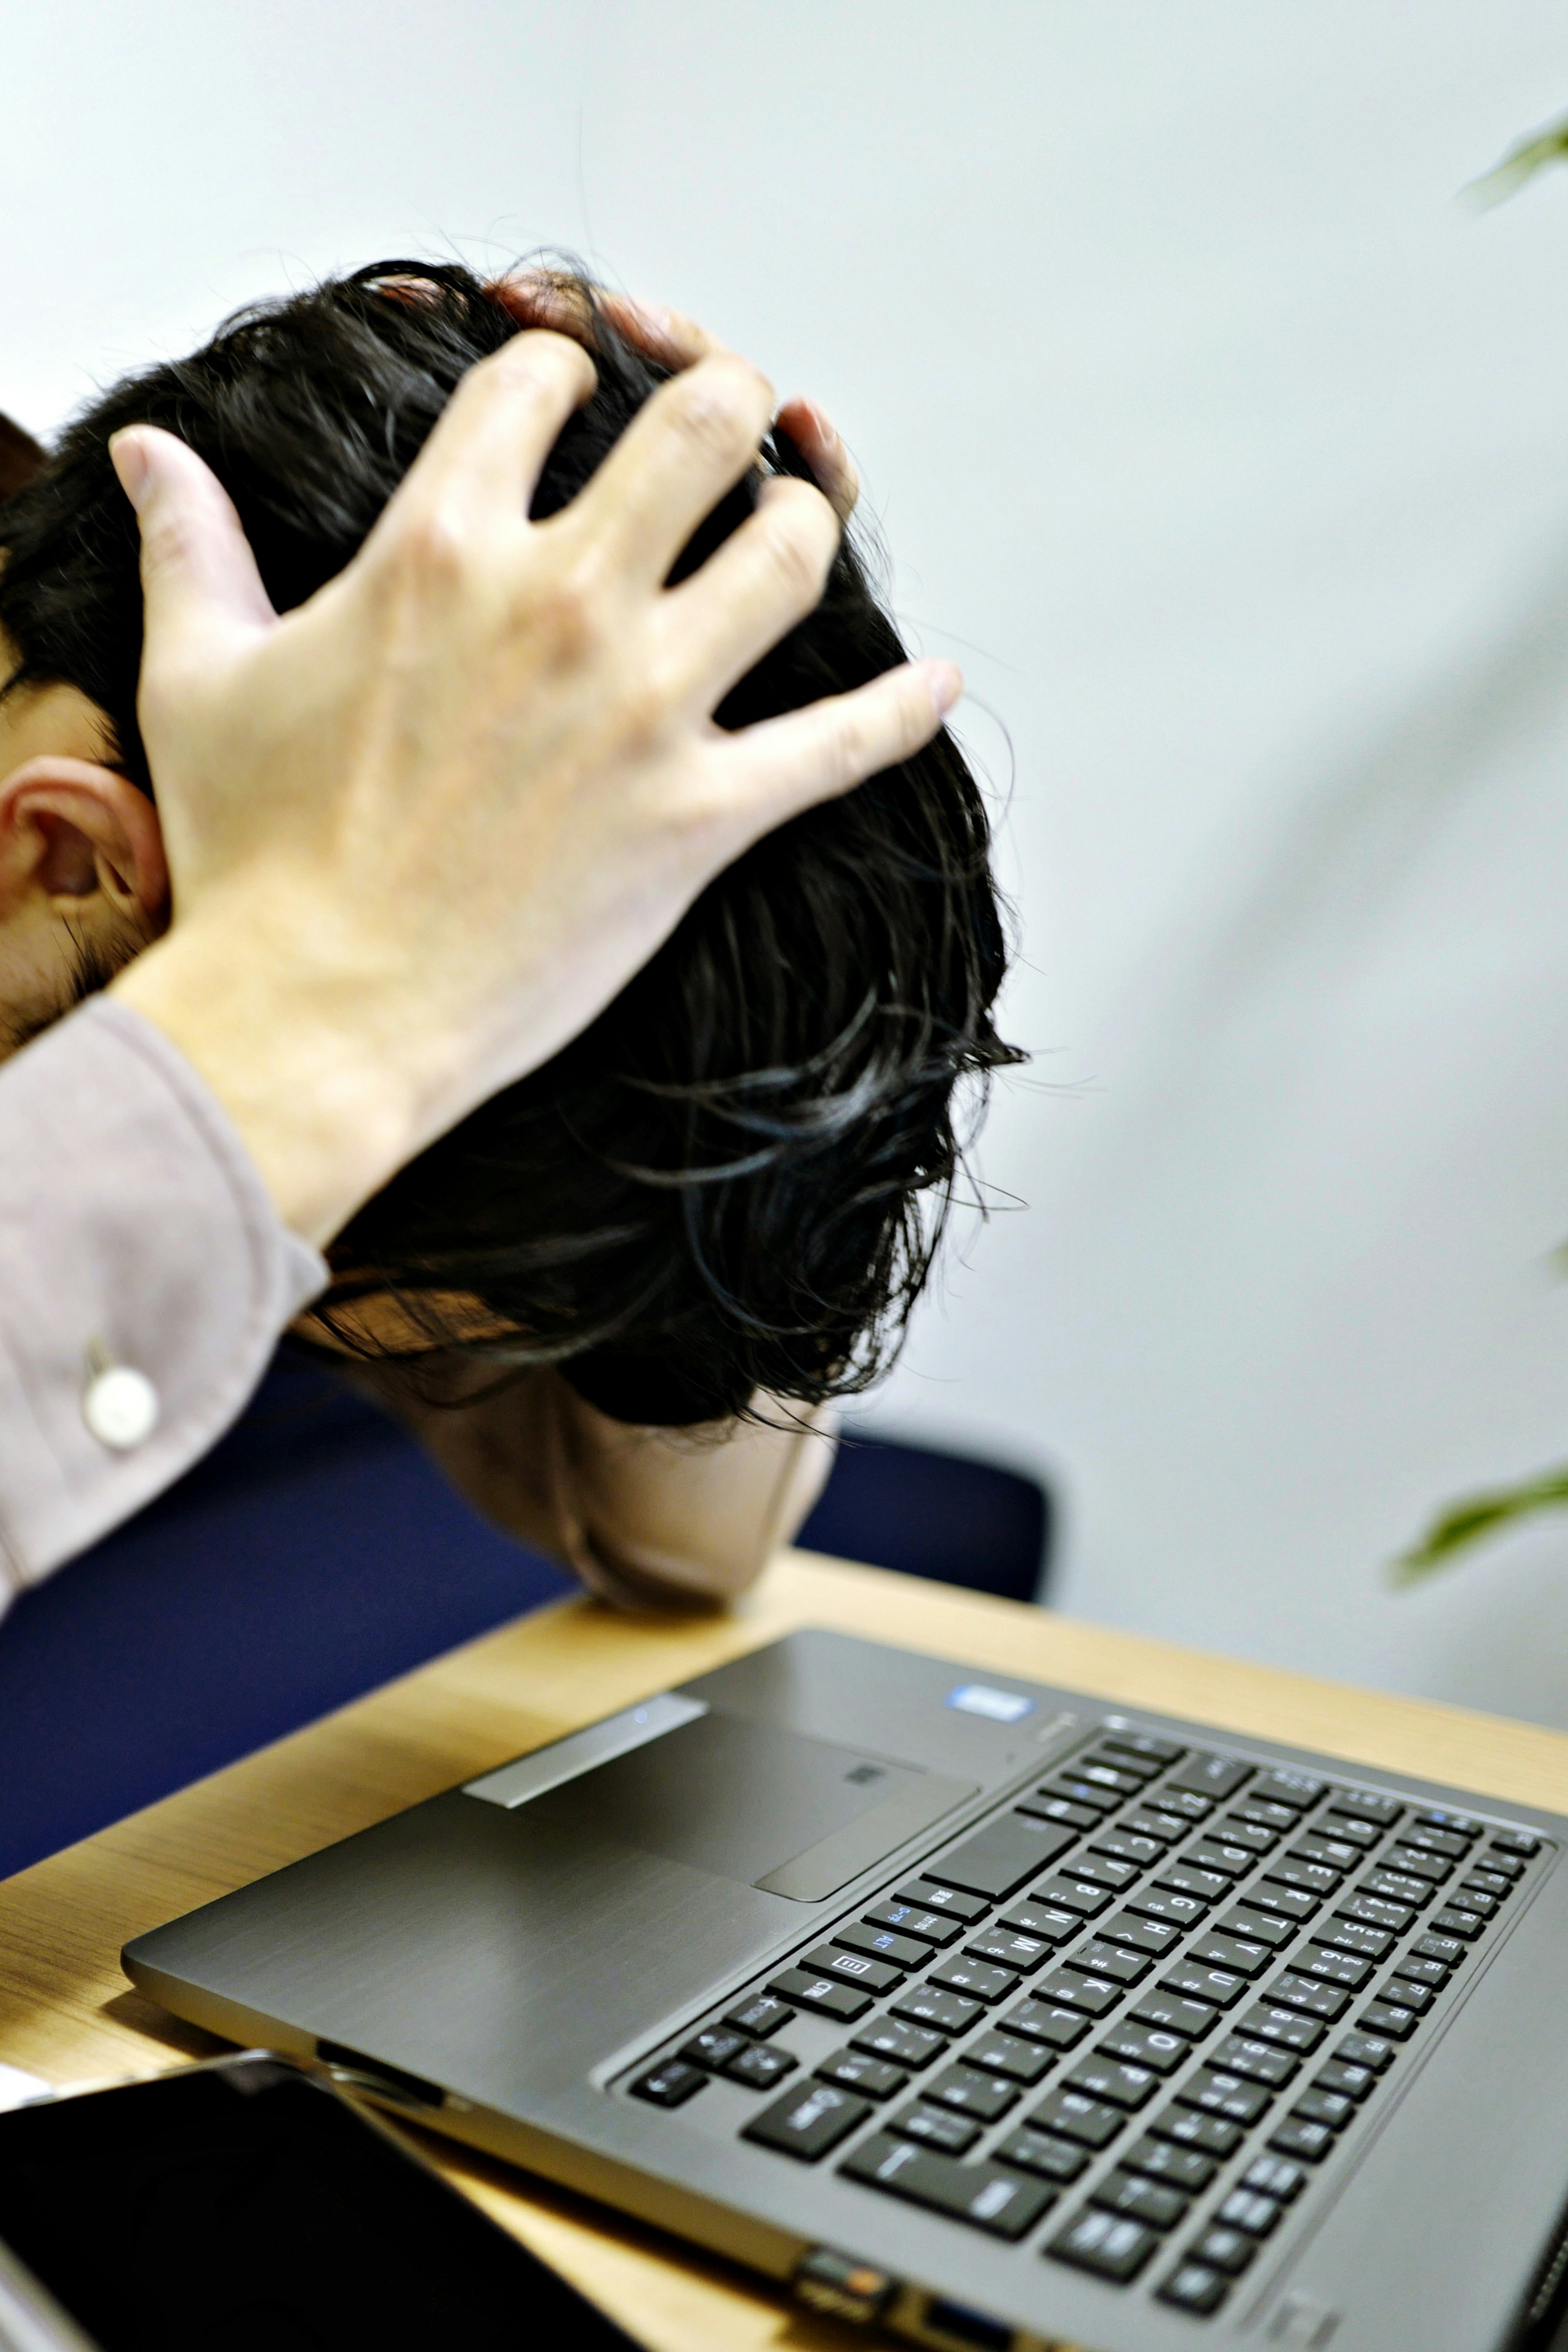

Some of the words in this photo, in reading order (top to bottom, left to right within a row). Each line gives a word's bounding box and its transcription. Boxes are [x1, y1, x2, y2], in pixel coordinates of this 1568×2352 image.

[1181, 1794, 1206, 1807] Z
[1159, 1815, 1181, 1828] X
[1246, 1825, 1270, 1837] S
[1131, 1837, 1156, 1850] C
[1223, 1847, 1247, 1860] D
[1327, 1843, 1352, 1858] W
[1406, 1850, 1427, 1860] 2
[1106, 1862, 1131, 1874] V
[1307, 1865, 1332, 1877] E
[1201, 1871, 1223, 1883] F
[1385, 1873, 1407, 1883] 3
[1076, 1884, 1100, 1896] B
[1049, 1893, 1067, 1901] こ
[1285, 1890, 1311, 1902] R
[1148, 1903, 1165, 1911] き
[1171, 1897, 1196, 1909] G
[1366, 1898, 1385, 1908] 4
[1045, 1910, 1073, 1924] N
[1143, 1922, 1170, 1935] H
[1236, 1923, 1253, 1931] か
[1262, 1917, 1287, 1929] T
[1344, 1923, 1365, 1933] 5
[1365, 1929, 1385, 1938] %
[873, 1935, 894, 1948] ALT
[1010, 1937, 1040, 1952] M
[1334, 1936, 1353, 1944] え
[1441, 1939, 1458, 1949] F5
[1091, 1943, 1105, 1952] END
[1236, 1944, 1262, 1955] Y
[1116, 1950, 1139, 1962] J
[1321, 1951, 1342, 1960] 6
[1342, 1957, 1363, 1965] &
[1091, 1959, 1108, 1968] ま
[1311, 1963, 1330, 1972] お
[1424, 1961, 1442, 1971] F6
[951, 1975, 970, 1984] ね
[1208, 1972, 1236, 1986] U
[1279, 1975, 1294, 1988] HOME
[803, 1982, 833, 1998] CTRL
[1083, 1979, 1111, 1993] K
[1182, 1981, 1200, 1989] な
[1298, 1980, 1320, 1991] 7
[1409, 1984, 1426, 1995] F7
[1056, 1989, 1075, 1999] の
[1288, 1995, 1307, 2003] や
[914, 2006, 934, 2016] る
[1051, 2009, 1079, 2020] L
[1152, 2011, 1172, 2022] に
[1270, 2010, 1293, 2021] 8
[1390, 2009, 1408, 2019] F8
[1148, 2034, 1178, 2050] O
[1365, 2041, 1385, 2052] F9
[1243, 2042, 1267, 2054] 9
[1120, 2067, 1149, 2084] P
